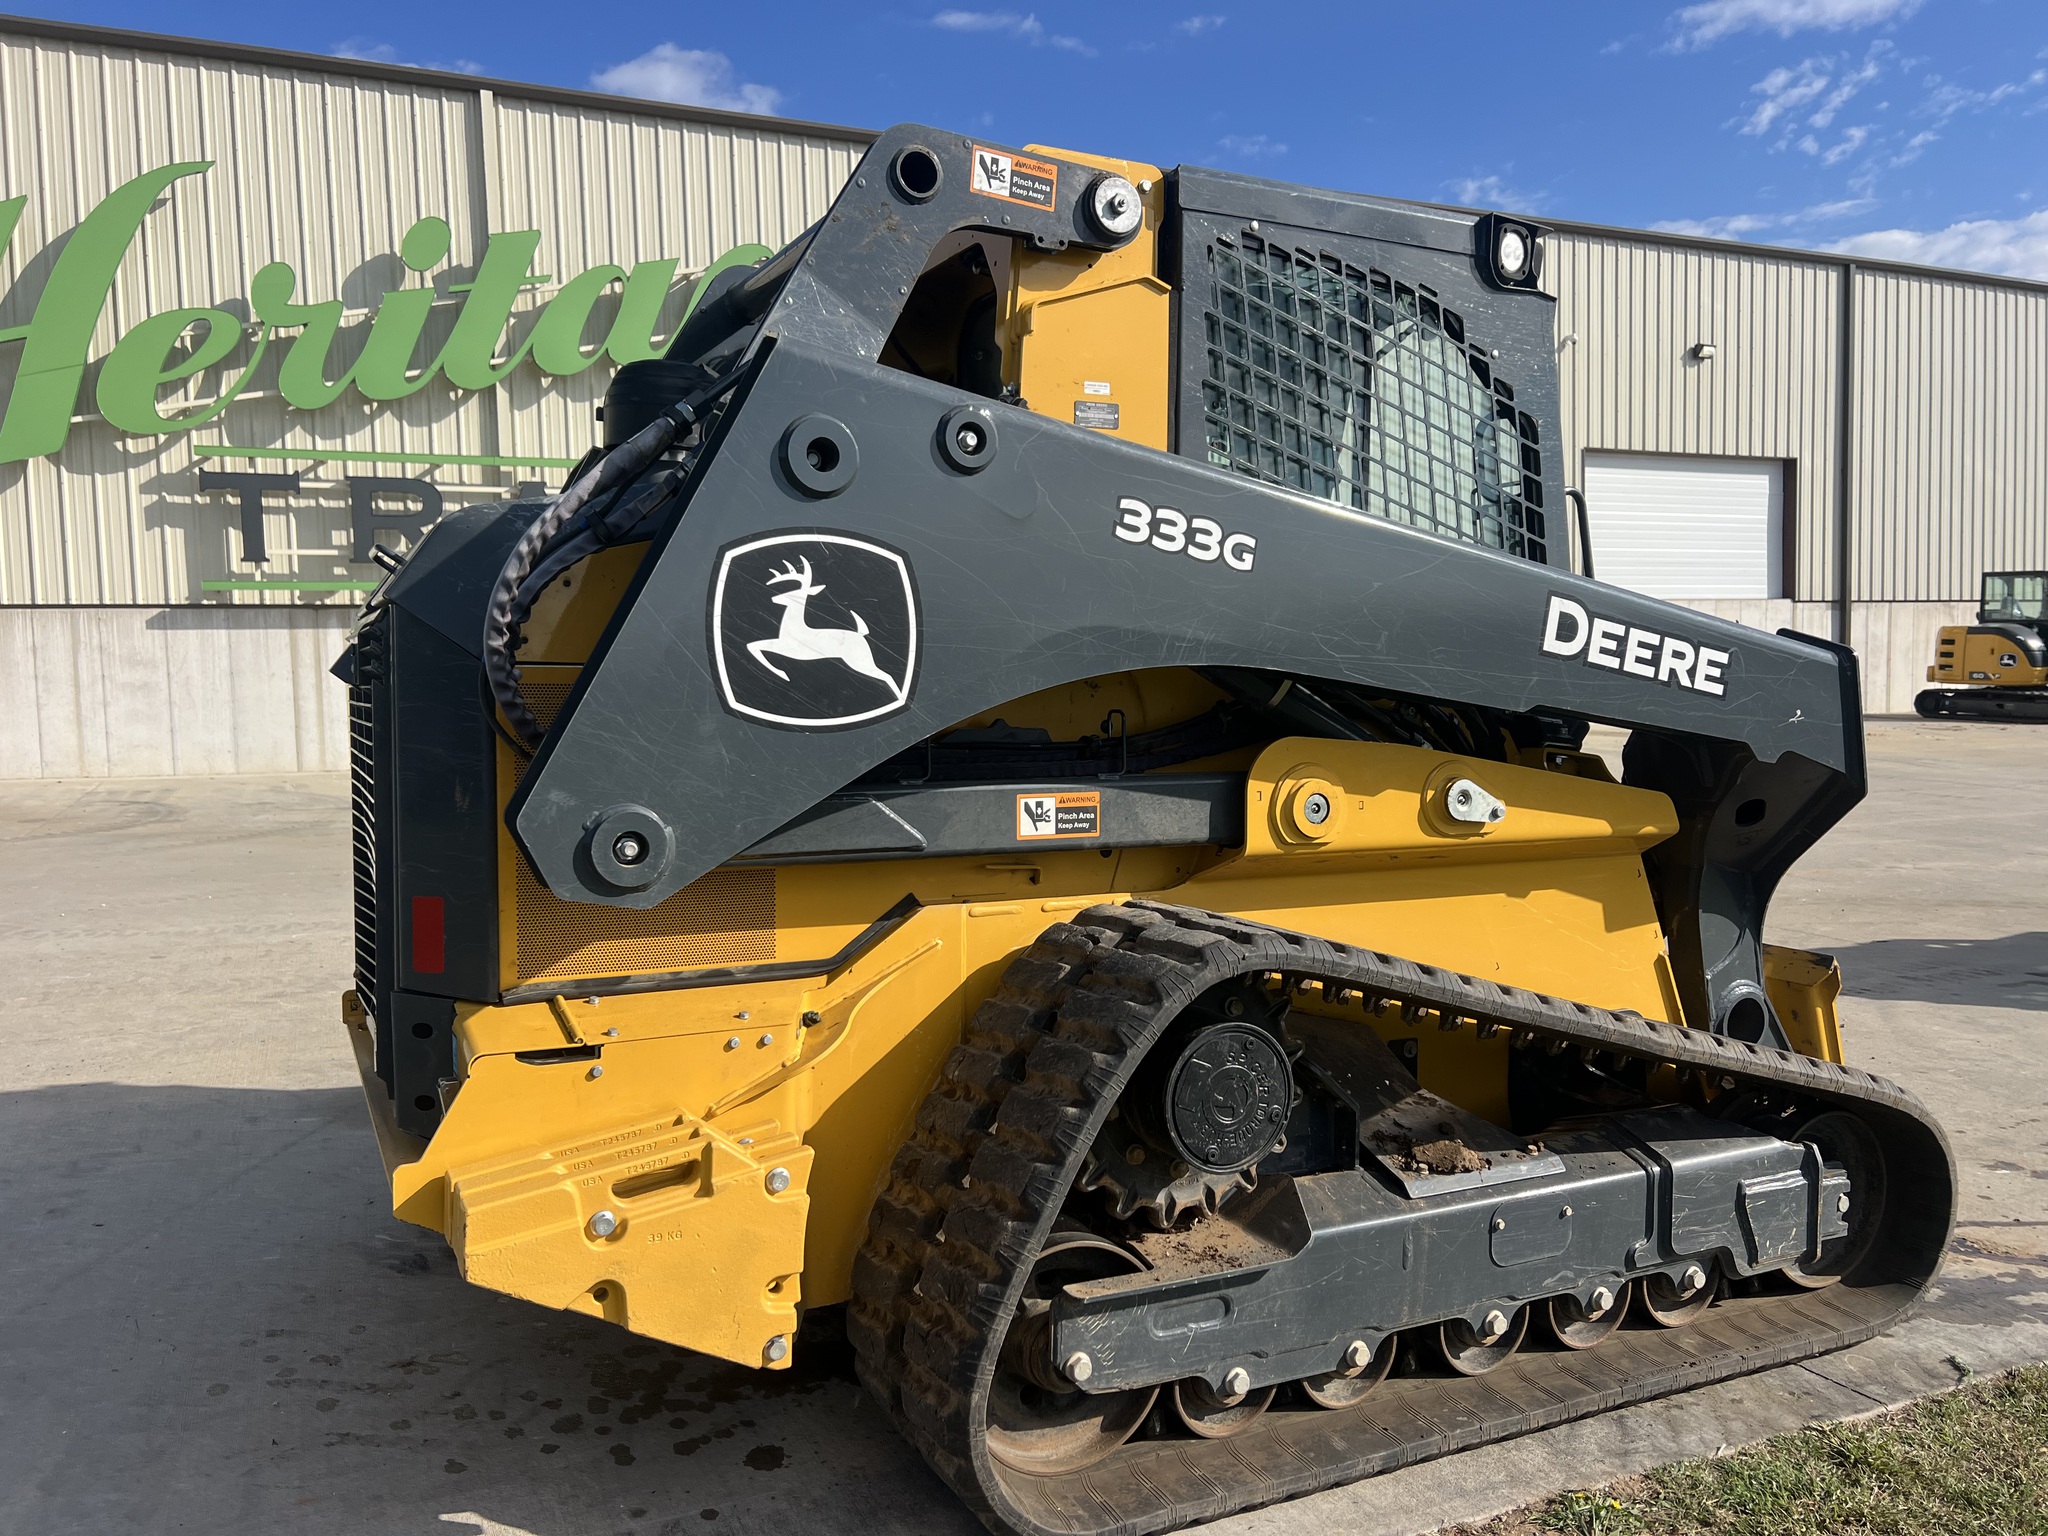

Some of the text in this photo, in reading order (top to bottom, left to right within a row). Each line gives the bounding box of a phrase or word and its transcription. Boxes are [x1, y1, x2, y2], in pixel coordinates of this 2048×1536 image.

[1020, 161, 1053, 176] WARNING
[1013, 176, 1050, 192] Pinch Area
[1012, 186, 1044, 201] Keep Away
[199, 467, 547, 564] TR
[1114, 497, 1257, 572] 333G
[1542, 595, 1730, 696] DEERE
[1065, 796, 1096, 804] WARNING
[559, 1147, 580, 1158] USA
[572, 1160, 595, 1172] USA
[614, 1142, 658, 1160] T245787
[581, 1175, 604, 1188] USA
[625, 1157, 669, 1175] T245787
[648, 1229, 684, 1245] 39 KG
